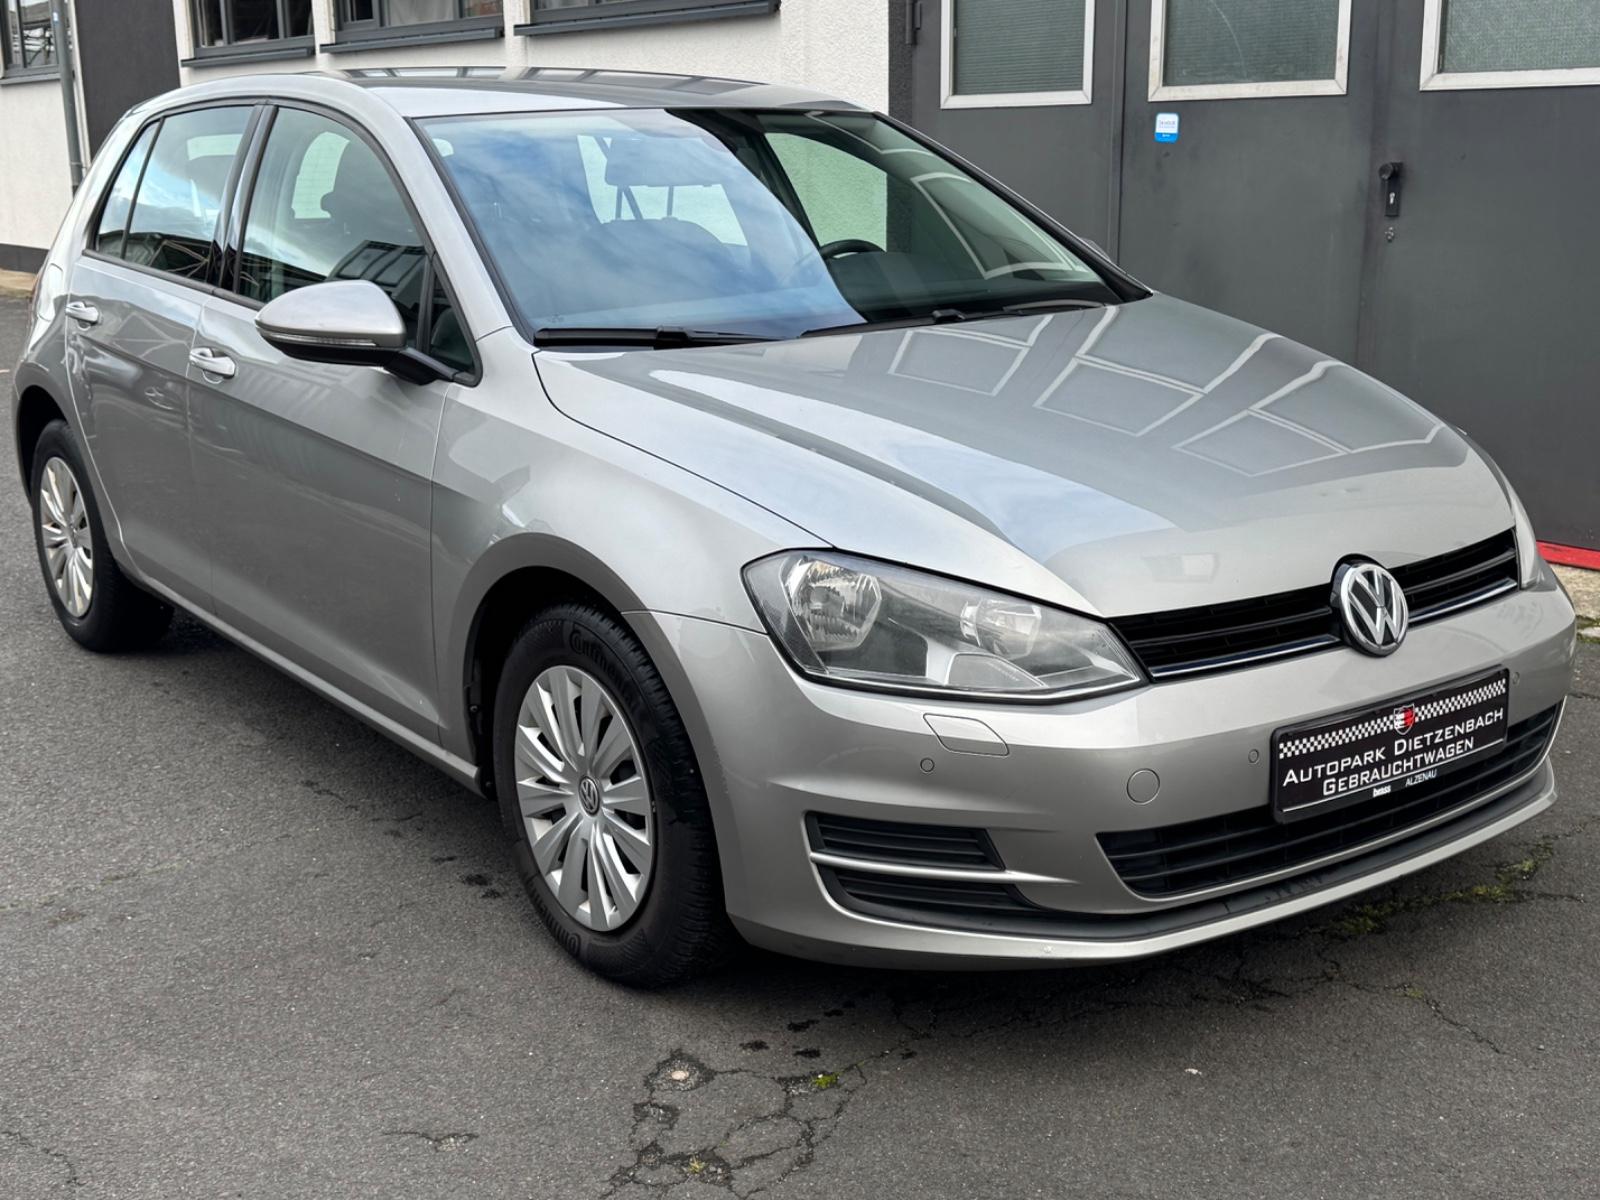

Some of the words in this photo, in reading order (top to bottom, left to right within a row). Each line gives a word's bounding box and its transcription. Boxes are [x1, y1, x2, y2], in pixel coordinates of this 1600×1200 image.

[1283, 747, 1386, 786] AUTOPARK
[1394, 708, 1503, 755] DIETZENBACH
[1323, 737, 1474, 796] GEBRAUCHTWAGEN
[1405, 768, 1437, 787] ALZENAU
